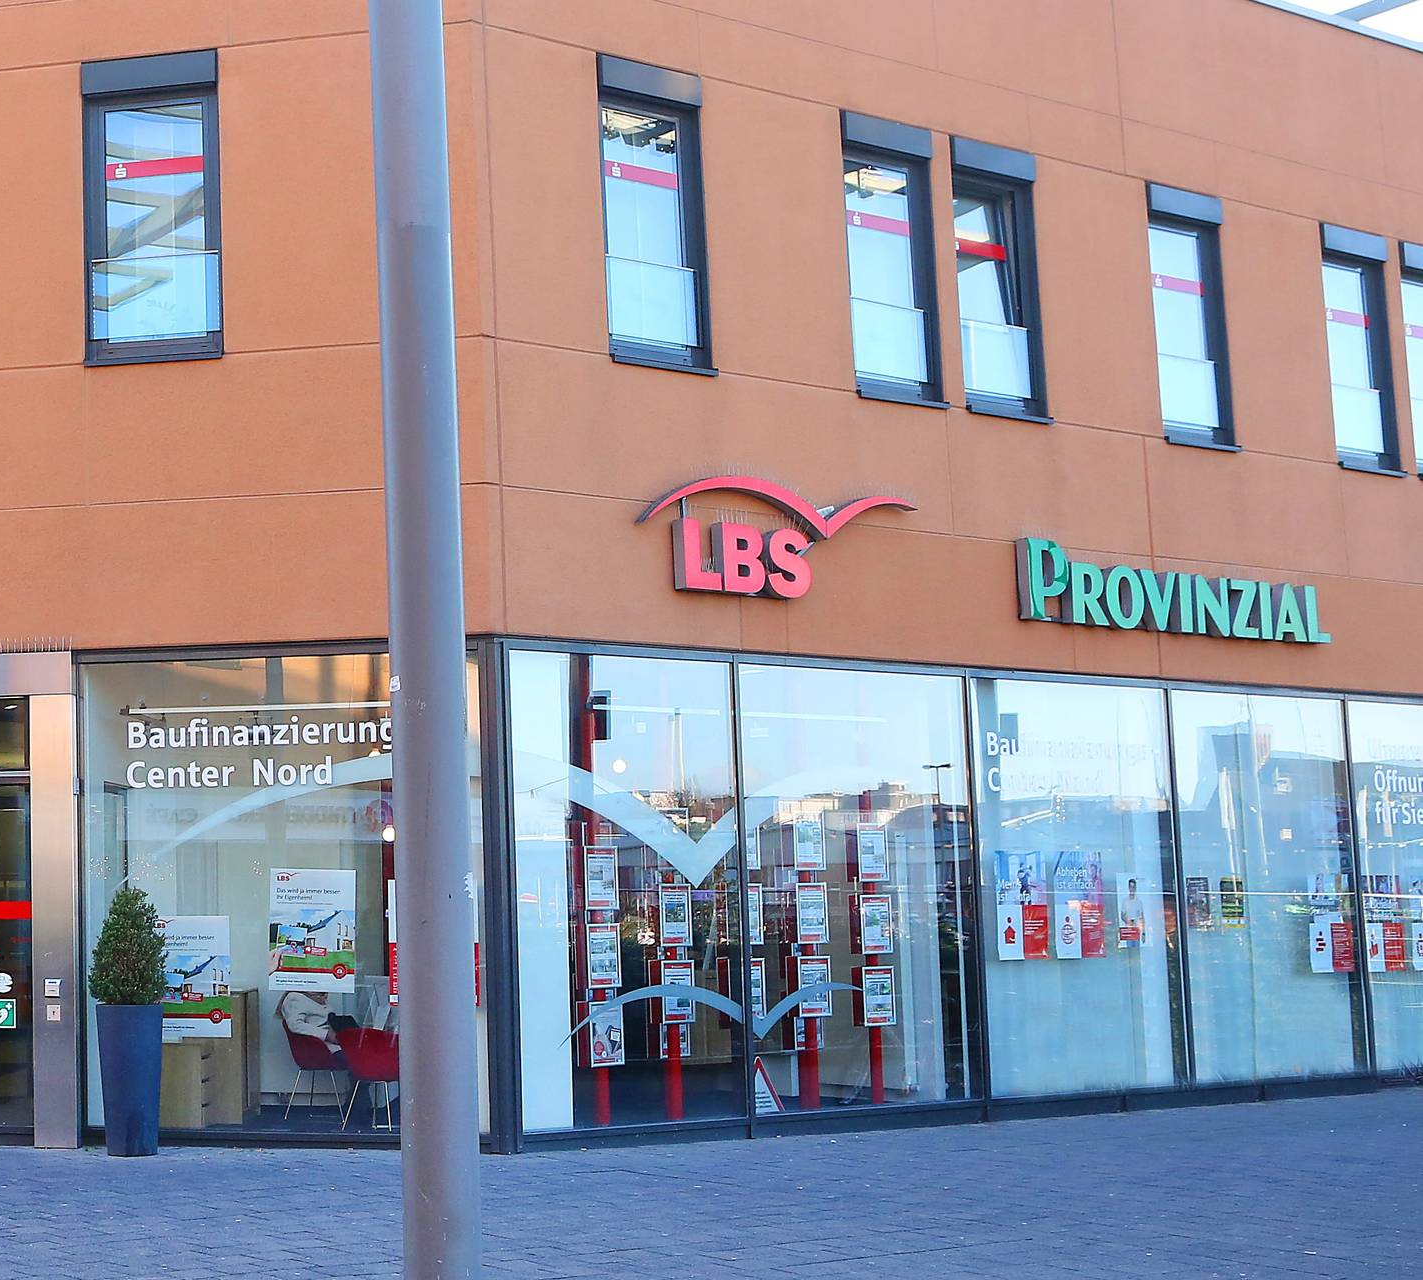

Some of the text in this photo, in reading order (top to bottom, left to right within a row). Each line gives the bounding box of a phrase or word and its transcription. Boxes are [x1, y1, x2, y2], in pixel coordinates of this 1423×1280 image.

[674, 518, 813, 600] LBS
[1018, 538, 1331, 643] PROVINZIAL
[127, 756, 332, 788] Center Nord
